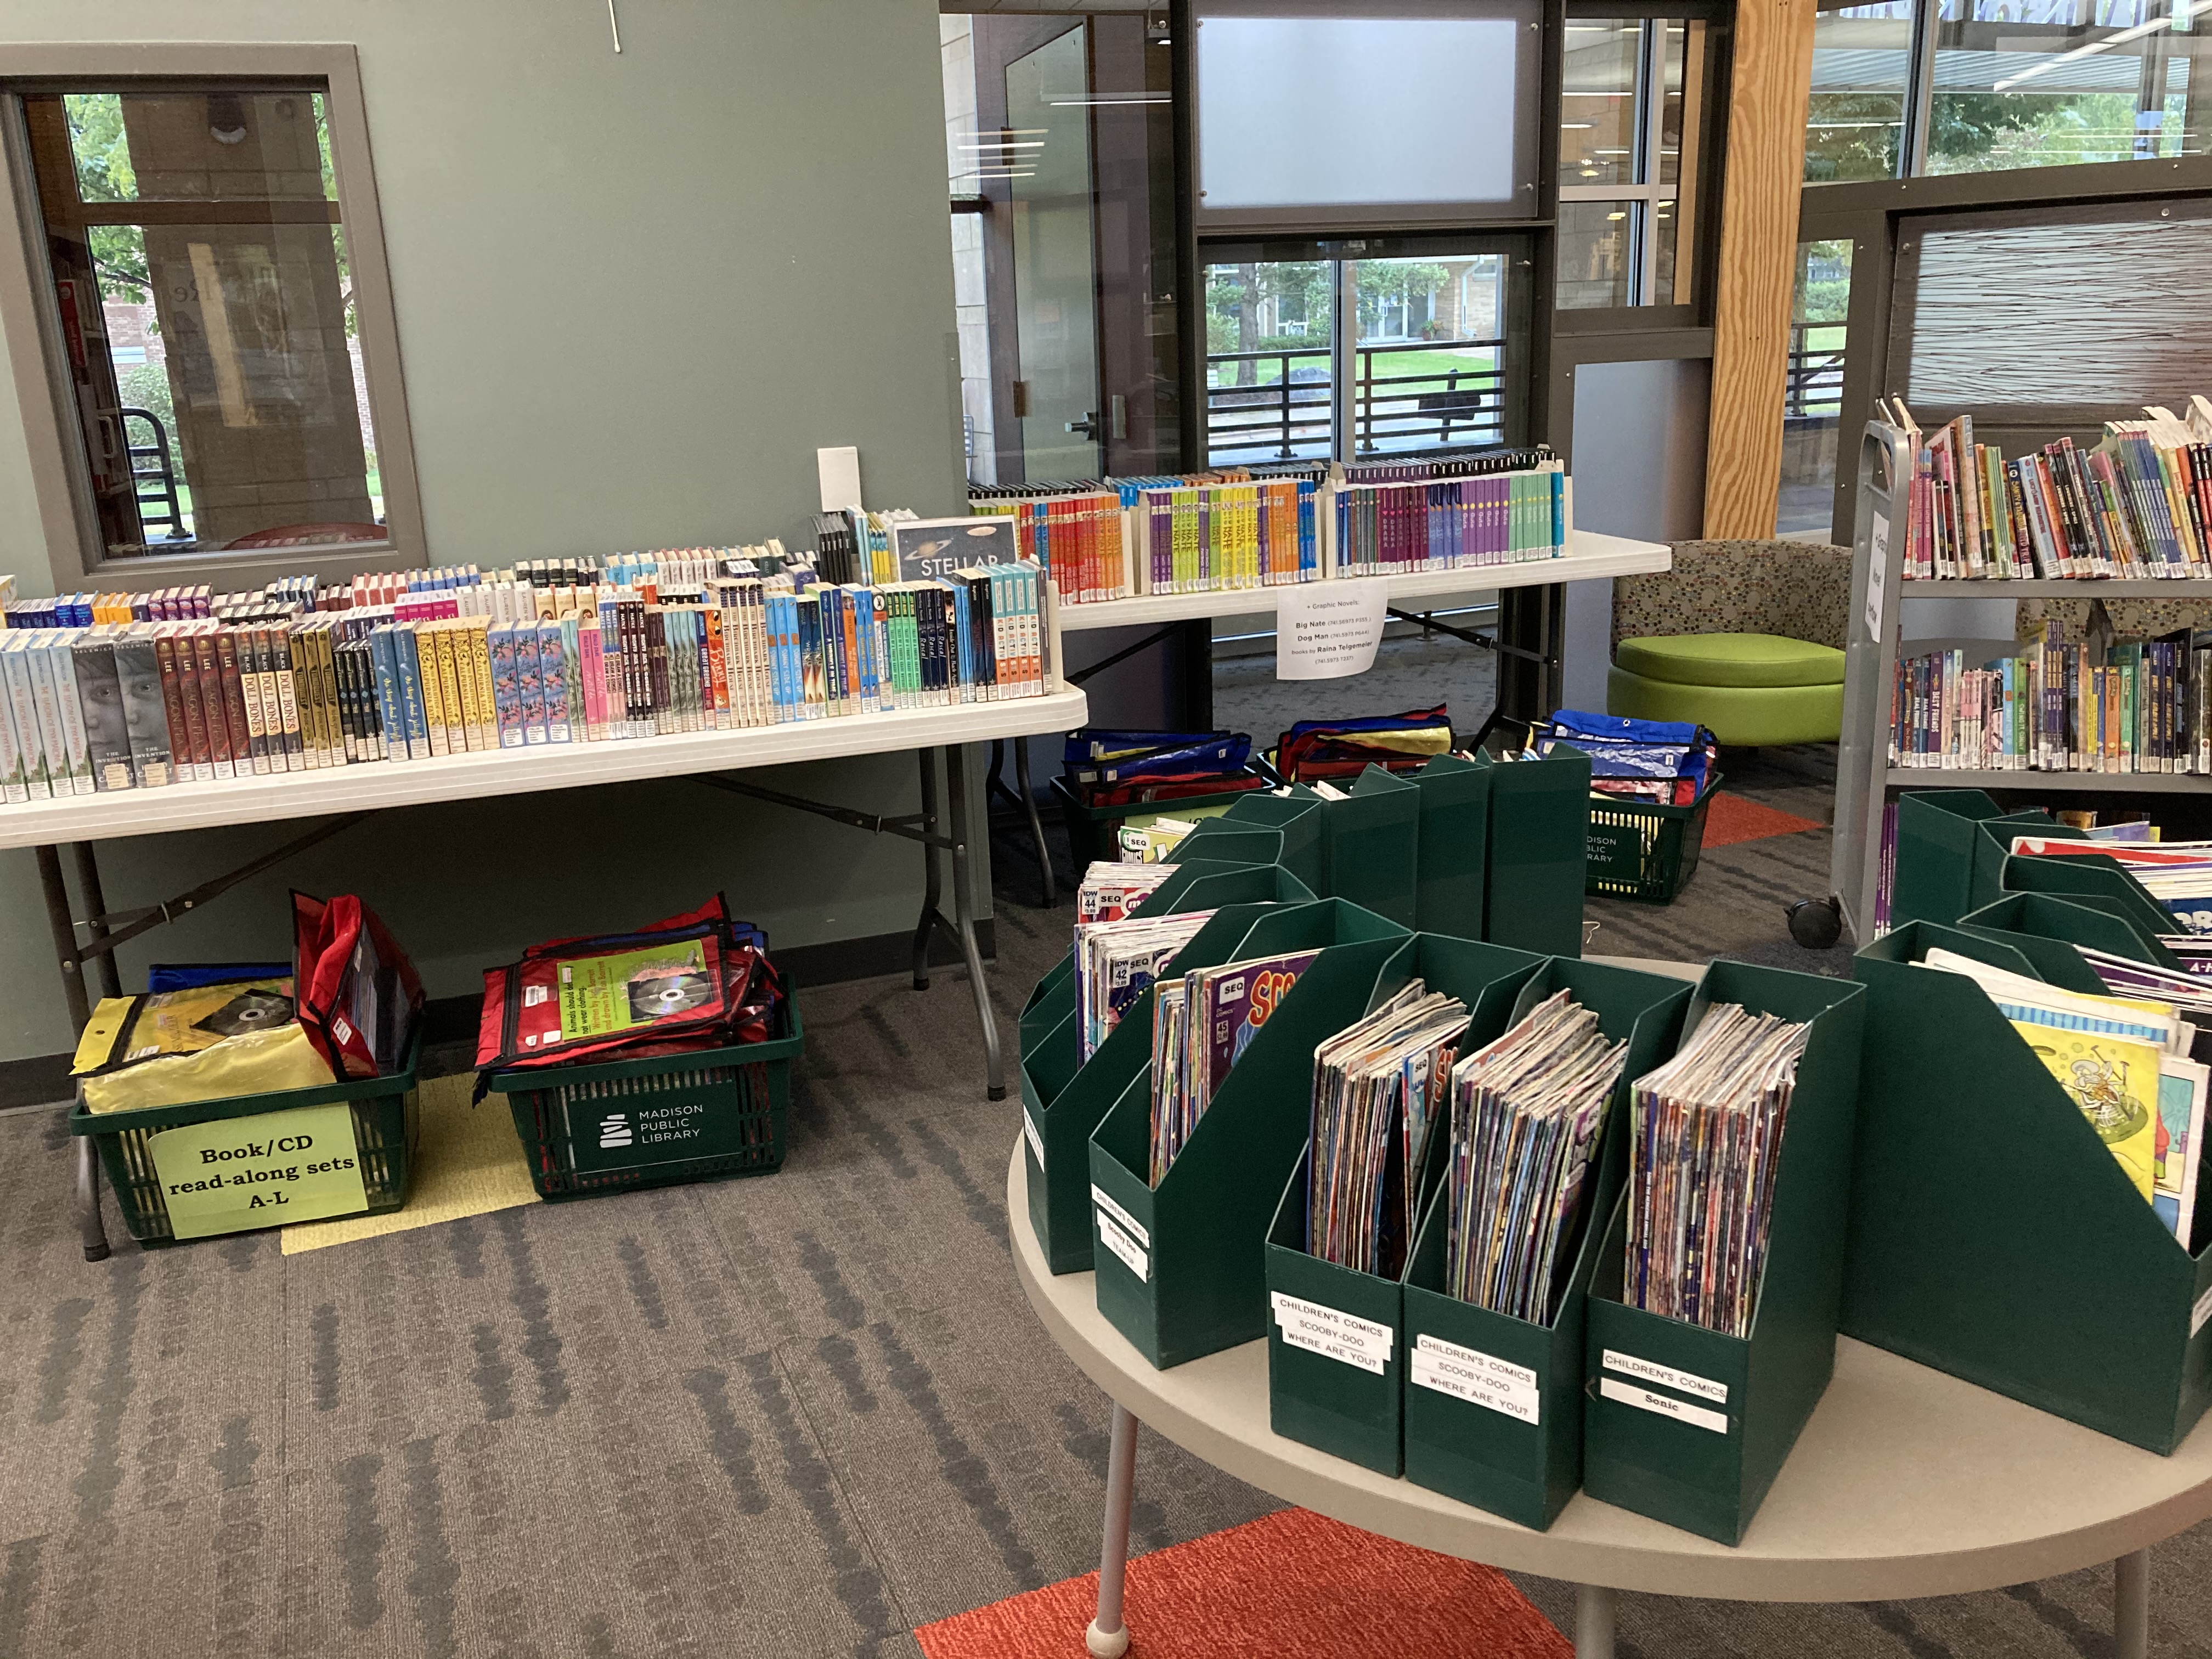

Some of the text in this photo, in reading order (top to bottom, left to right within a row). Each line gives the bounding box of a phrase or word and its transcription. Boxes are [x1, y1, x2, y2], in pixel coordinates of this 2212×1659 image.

[920, 637, 928, 659] Rascal
[1339, 641, 1373, 651] Telgemeier
[203, 659, 211, 670] LEE
[710, 647, 727, 687] Binny
[422, 665, 433, 703] CALPURNIA
[476, 661, 486, 698] CALPURNIA
[585, 670, 596, 701] Matilda
[595, 668, 606, 699] Matilda
[245, 678, 262, 733] DOLL BONES
[262, 676, 278, 731] DOLL BONES
[280, 674, 296, 729] DOLL BONES
[1931, 691, 1941, 733] BEST FRIENDS
[1586, 845, 1606, 853] BLIC
[1587, 836, 1617, 845] DISON
[1121, 848, 1143, 864] COMICS
[1587, 853, 1613, 862] RARY
[1085, 900, 1096, 908] 44
[597, 961, 607, 983] Barrett
[1115, 959, 1129, 968] IDW
[1130, 958, 1149, 969] SEQ
[587, 969, 596, 990] Barrett
[1116, 969, 1127, 980] 42
[577, 986, 588, 1009] clothing.
[602, 991, 611, 1002] by
[1224, 982, 1243, 995] SEQ
[565, 991, 575, 1011] should
[590, 998, 600, 1011] by
[568, 1011, 578, 1032] Animals
[590, 1011, 601, 1030] Written
[603, 1003, 611, 1021] drawn
[1218, 1022, 1227, 1031] 45
[639, 1104, 703, 1120] MADISON
[641, 1118, 690, 1132] PUBLIC
[642, 1128, 700, 1143] LIBRARY
[200, 1135, 313, 1164] Book/CD
[168, 1158, 354, 1195] read-along sets
[249, 1191, 289, 1209] A-L
[1097, 1192, 1147, 1239] CHILDREN'S COMICS
[1108, 1222, 1136, 1254] Scooby Doo
[1113, 1241, 1134, 1264] TEAM-UP
[1280, 1299, 1383, 1338] CHILDREN'S COMICS
[1300, 1320, 1364, 1347] SCOOBY-DOO
[1288, 1331, 1377, 1367] WHERE ARE YOU?
[1421, 1339, 1531, 1383] CHILDREN'S COMICS
[1438, 1362, 1510, 1392] SCOOBY-DOO
[1605, 1355, 1726, 1398] CHILDREN'S COMICS
[1430, 1376, 1528, 1415] WHERE ARE YOU?
[1645, 1394, 1679, 1411] Sonic
